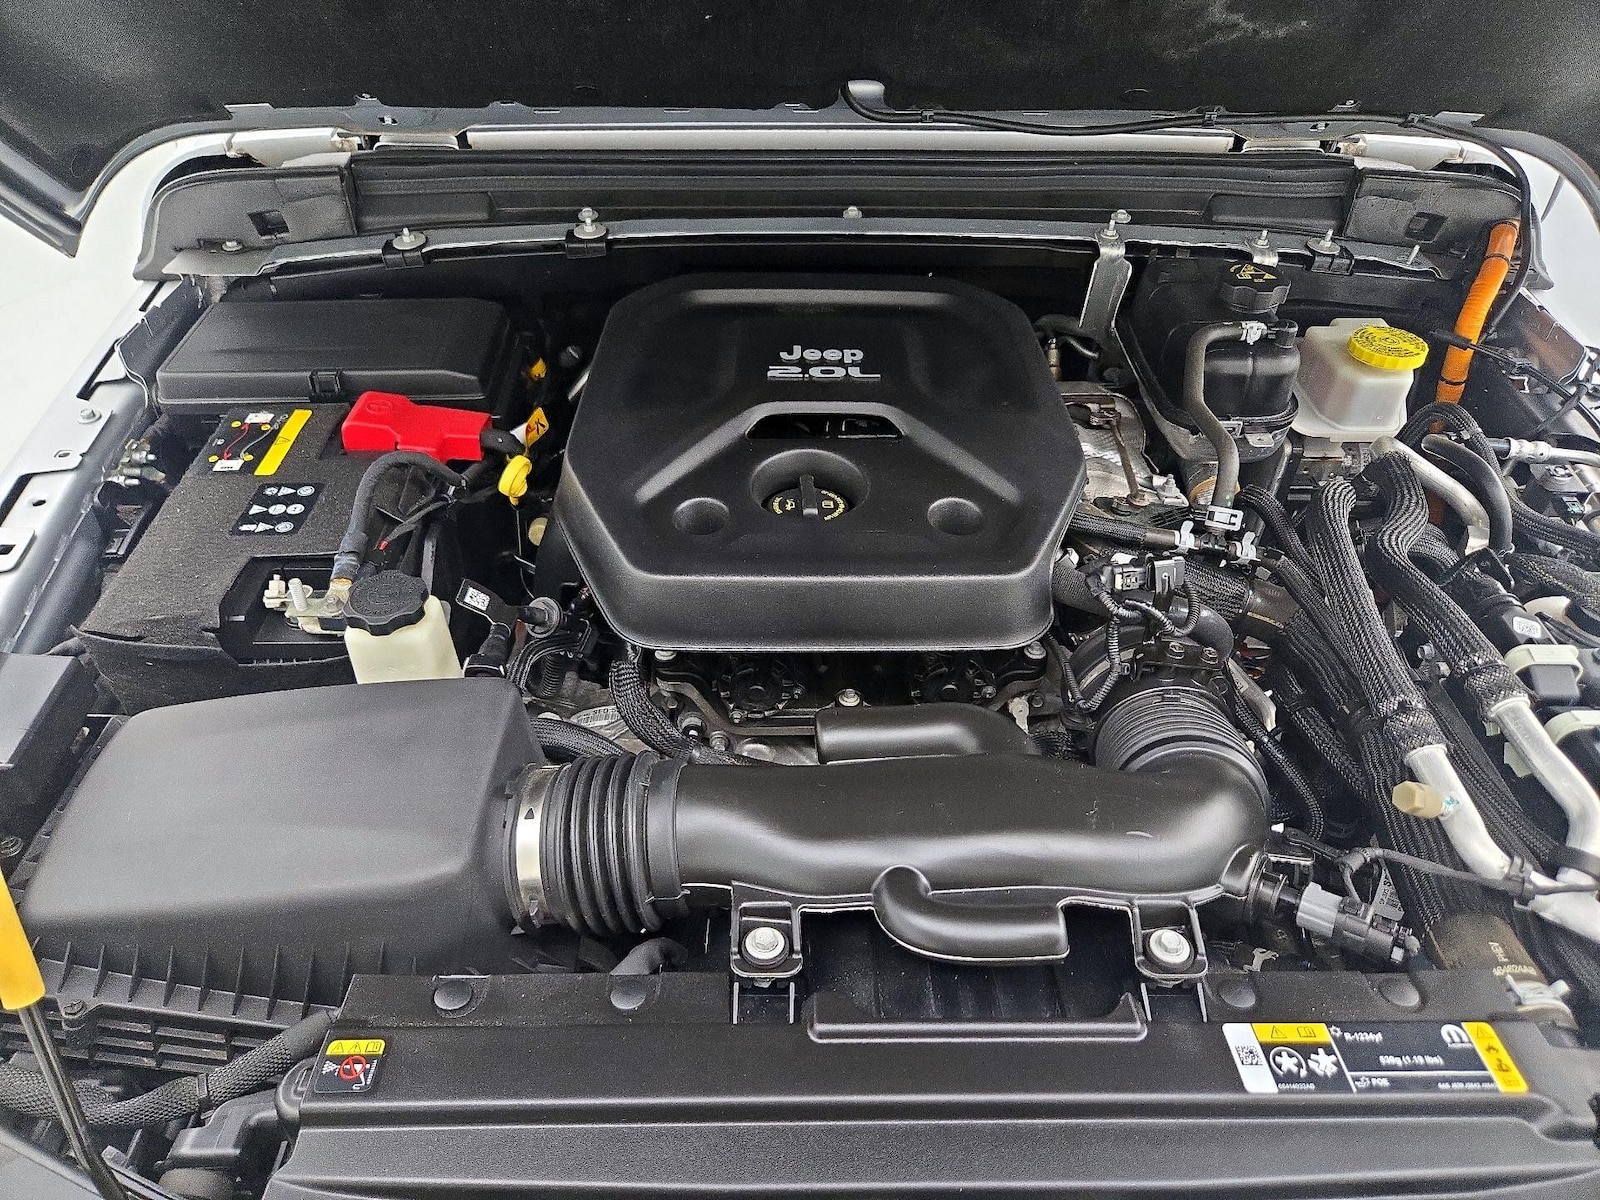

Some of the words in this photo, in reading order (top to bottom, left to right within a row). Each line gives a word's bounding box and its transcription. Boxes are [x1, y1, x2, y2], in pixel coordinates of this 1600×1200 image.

[779, 344, 864, 364] Jeep
[766, 365, 881, 379] 2.0L
[1371, 1077, 1391, 1088] POE
